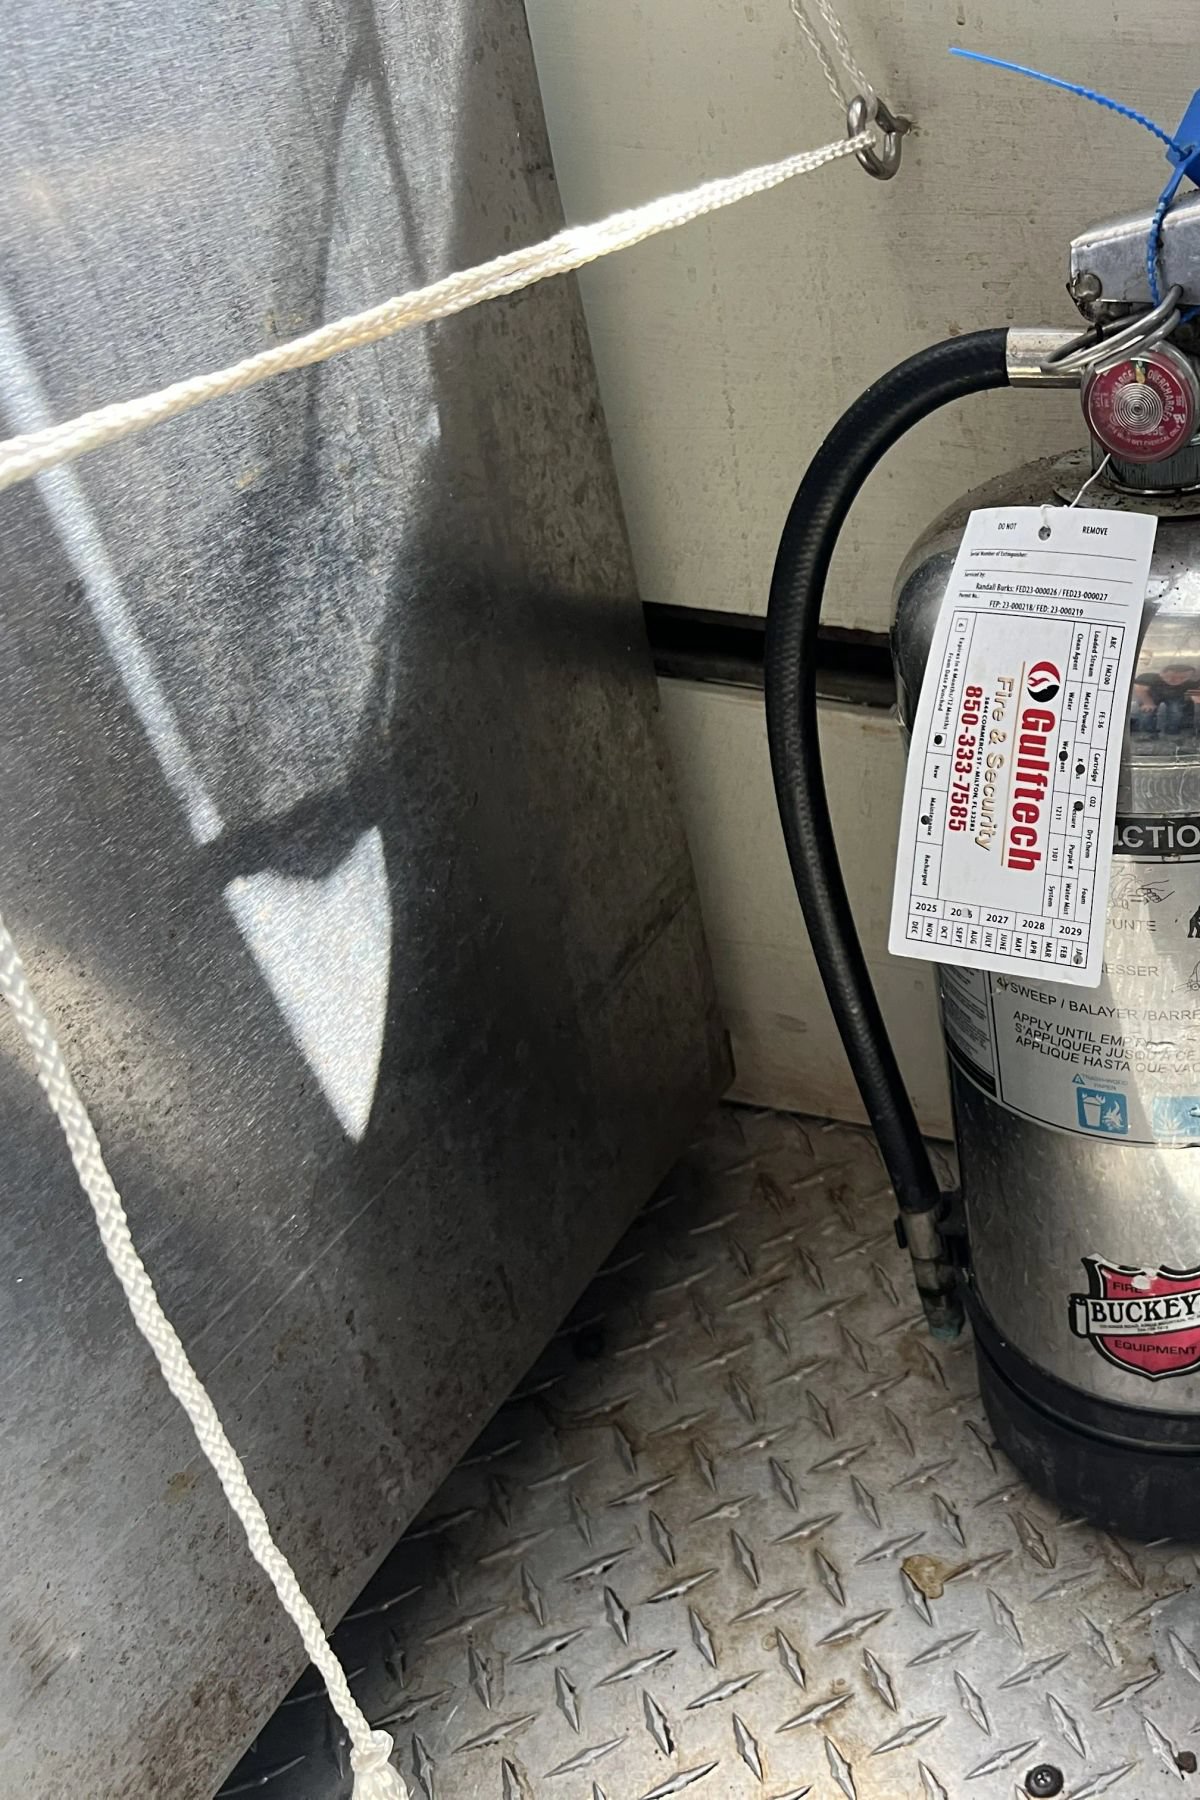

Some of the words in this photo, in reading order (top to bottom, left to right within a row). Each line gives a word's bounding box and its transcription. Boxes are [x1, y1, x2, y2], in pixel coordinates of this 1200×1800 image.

[1148, 370, 1174, 422] OVERCHARGED
[1082, 526, 1108, 536] REMOVE
[976, 583, 996, 591] Randall
[997, 584, 1014, 592] Burks:
[1016, 586, 1058, 596] FED23-000026
[1062, 590, 1108, 601] FED23-000027
[1050, 606, 1084, 616] 23-000219
[1091, 631, 1100, 654] Loaded
[1072, 651, 1081, 670] Agent
[1088, 654, 1098, 677] Stream
[1104, 664, 1112, 685] FM200
[938, 685, 948, 712] Punched
[992, 677, 1014, 722] Fire
[1067, 692, 1076, 711] Water
[1084, 692, 1092, 710] Metal
[943, 706, 952, 730] Months
[1080, 710, 1090, 735] Powder
[978, 714, 988, 756] COMMERCE
[988, 728, 1007, 745] &
[948, 684, 983, 832] 850-333-7585
[976, 756, 982, 766] ST
[1092, 753, 1100, 782] Cartridge
[1008, 708, 1056, 871] Gulftech
[975, 752, 1004, 851] Security
[1086, 830, 1094, 840] Dry
[922, 854, 930, 886] Recharged
[915, 902, 938, 913] 2025
[986, 914, 1009, 924] 2027
[1022, 920, 1045, 930] 2028
[956, 927, 964, 944] SEPT
[1000, 933, 1008, 950] JUNE
[1059, 926, 1082, 936] 2029
[1010, 982, 1056, 1005] SWEEP
[1069, 1000, 1137, 1019] BALAYER
[1013, 1010, 1053, 1032] APPLY
[1056, 1024, 1096, 1042] UNTIL
[1015, 1022, 1102, 1055] S'APPLIQUER
[1016, 1035, 1080, 1064] APPLIQUE
[1084, 1056, 1131, 1072] HASTA
[1136, 1062, 1168, 1073] QUE
[1114, 1340, 1198, 1356] EQUIPMENT
